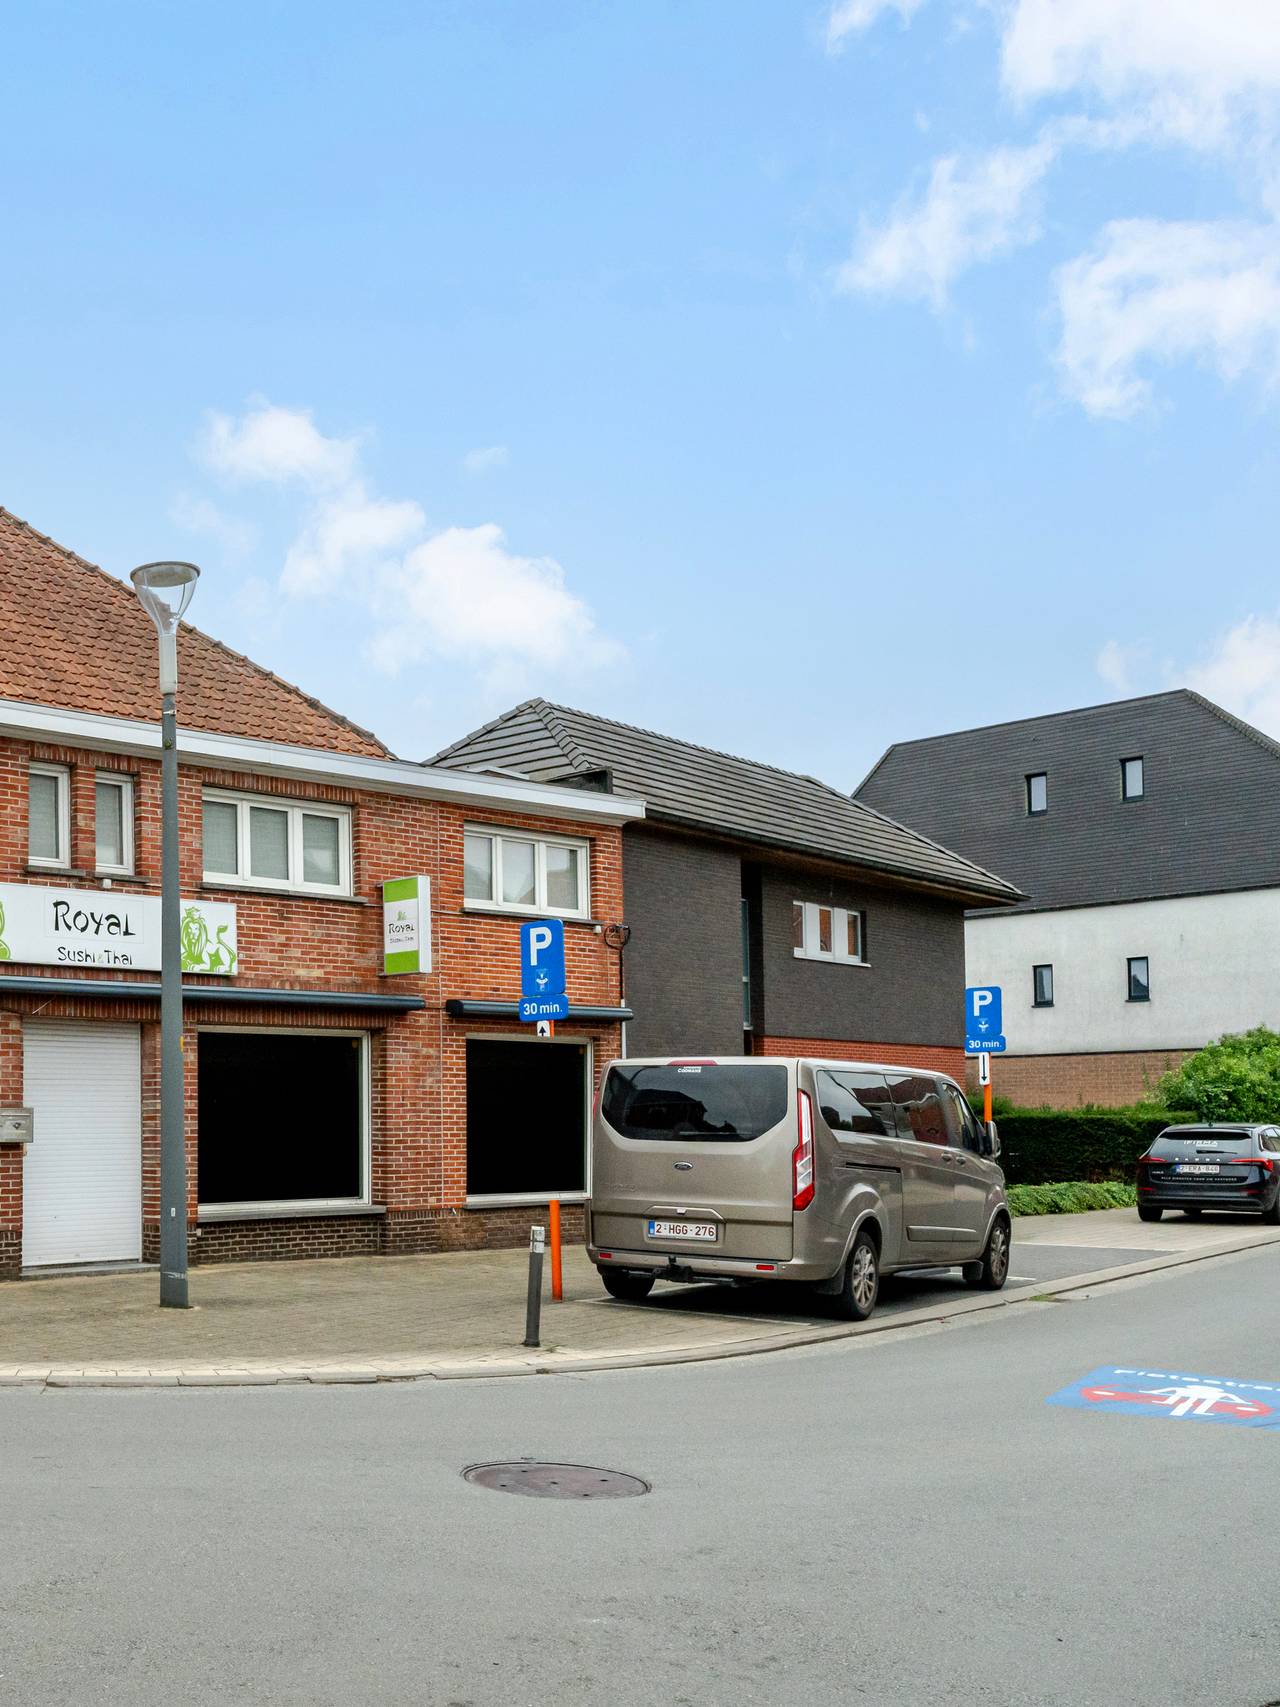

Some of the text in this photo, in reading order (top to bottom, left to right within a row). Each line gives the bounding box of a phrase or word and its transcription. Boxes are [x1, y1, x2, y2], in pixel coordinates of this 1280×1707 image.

[530, 926, 552, 966] P
[57, 946, 96, 963] Sushi
[104, 948, 133, 965] Thai
[523, 1001, 563, 1016] 30 min.
[973, 990, 993, 1017] P
[968, 1039, 1002, 1049] 30 min.
[656, 1223, 715, 1237] 2-HGG-276
